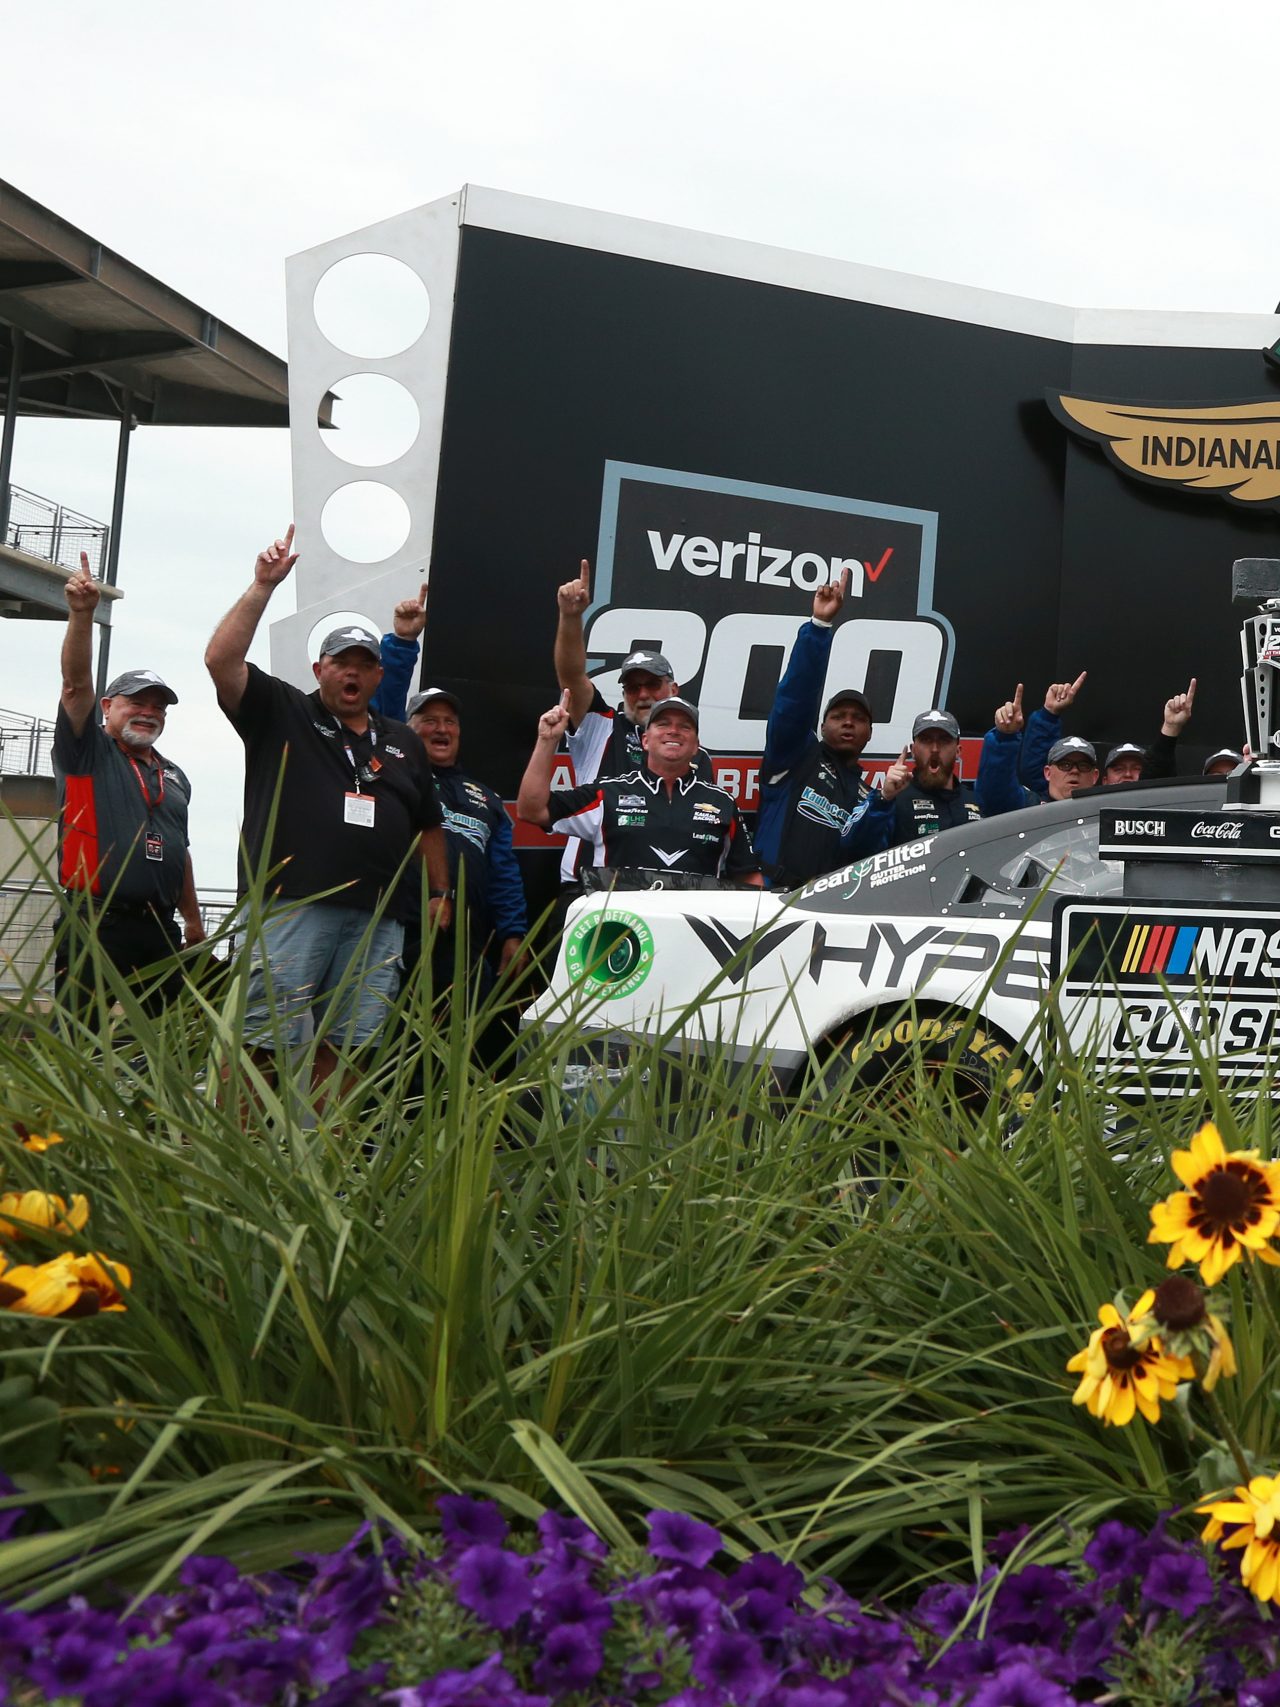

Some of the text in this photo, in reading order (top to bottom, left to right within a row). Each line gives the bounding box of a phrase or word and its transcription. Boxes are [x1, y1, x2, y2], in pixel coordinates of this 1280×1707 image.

[647, 529, 865, 598] verizon
[585, 607, 944, 754] 200
[1113, 819, 1166, 838] BUSCH
[1190, 821, 1244, 840] Coca-Cola
[869, 864, 905, 881] GUTTER
[870, 863, 927, 889] PROTECTION
[574, 919, 593, 939] GET
[808, 922, 1051, 1002] HYPE
[1112, 1003, 1219, 1054] CUP
